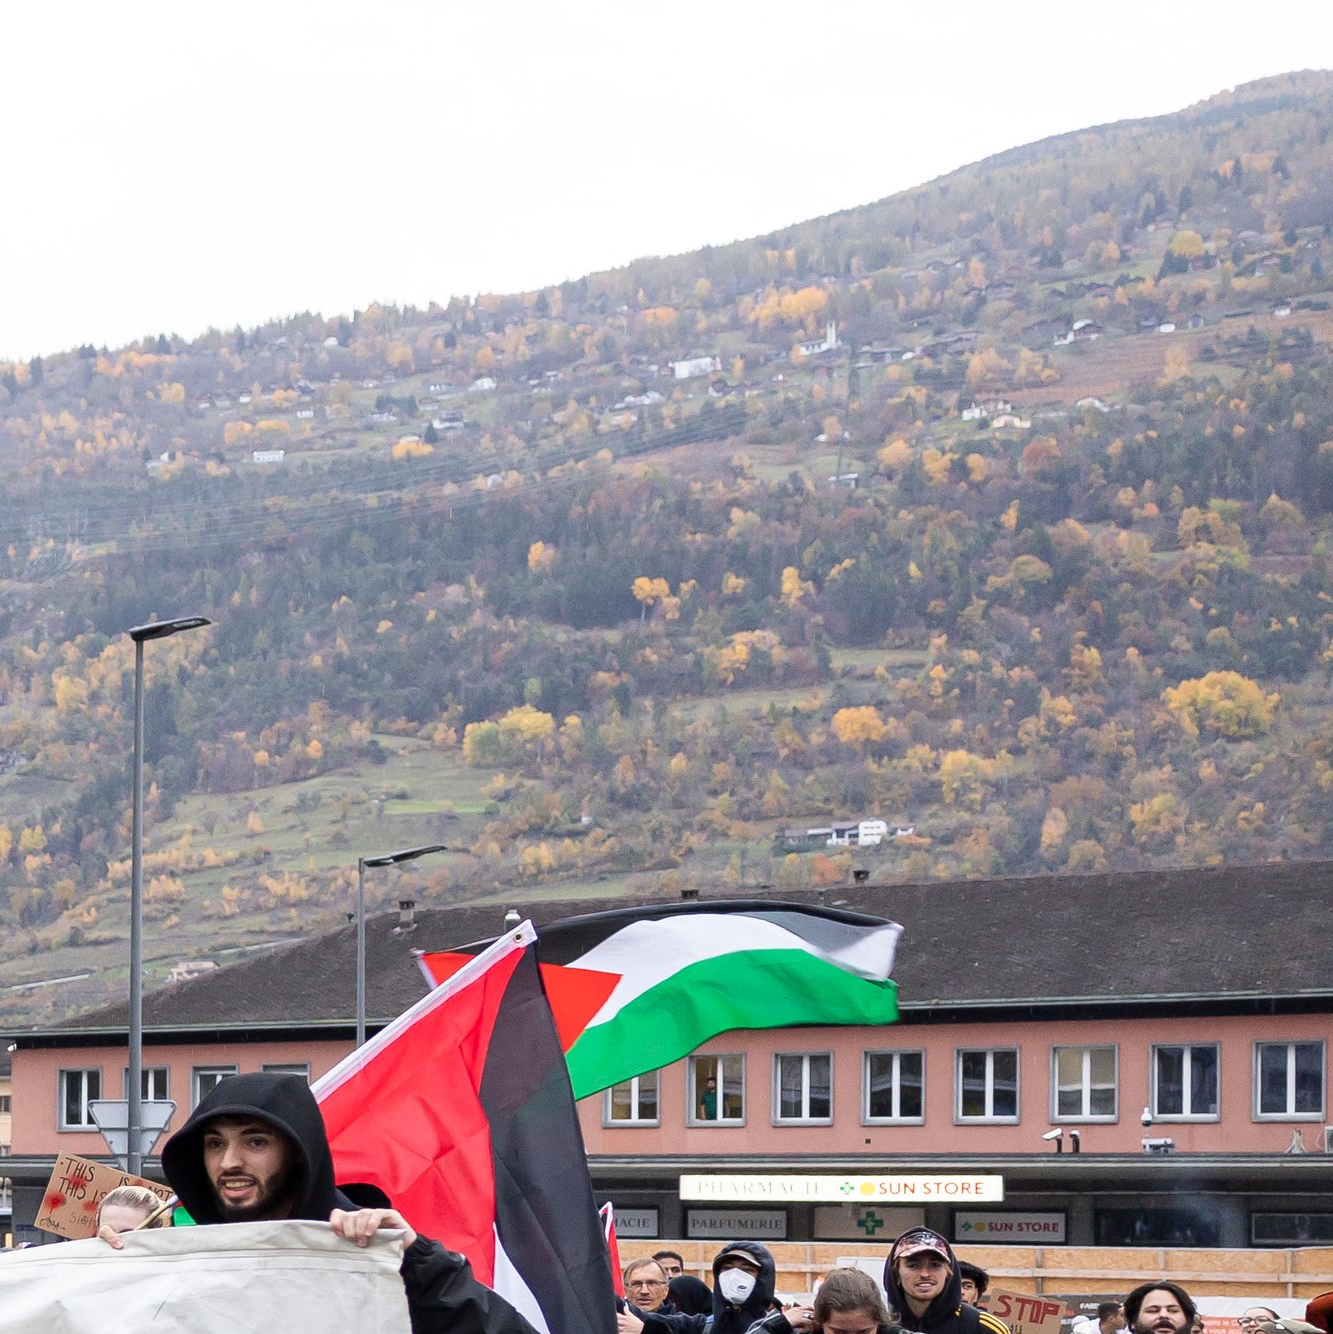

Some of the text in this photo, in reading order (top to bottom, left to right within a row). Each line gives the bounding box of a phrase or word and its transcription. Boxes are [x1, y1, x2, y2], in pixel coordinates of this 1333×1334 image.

[65, 1157, 96, 1182] THIS
[59, 1176, 87, 1200] THIS
[697, 1181, 984, 1195] PHARMACIE SUN STORE
[691, 1218, 783, 1230] PARFUMERIE
[988, 1222, 1059, 1233] SUN STORE
[993, 1294, 1061, 1325] STOP
